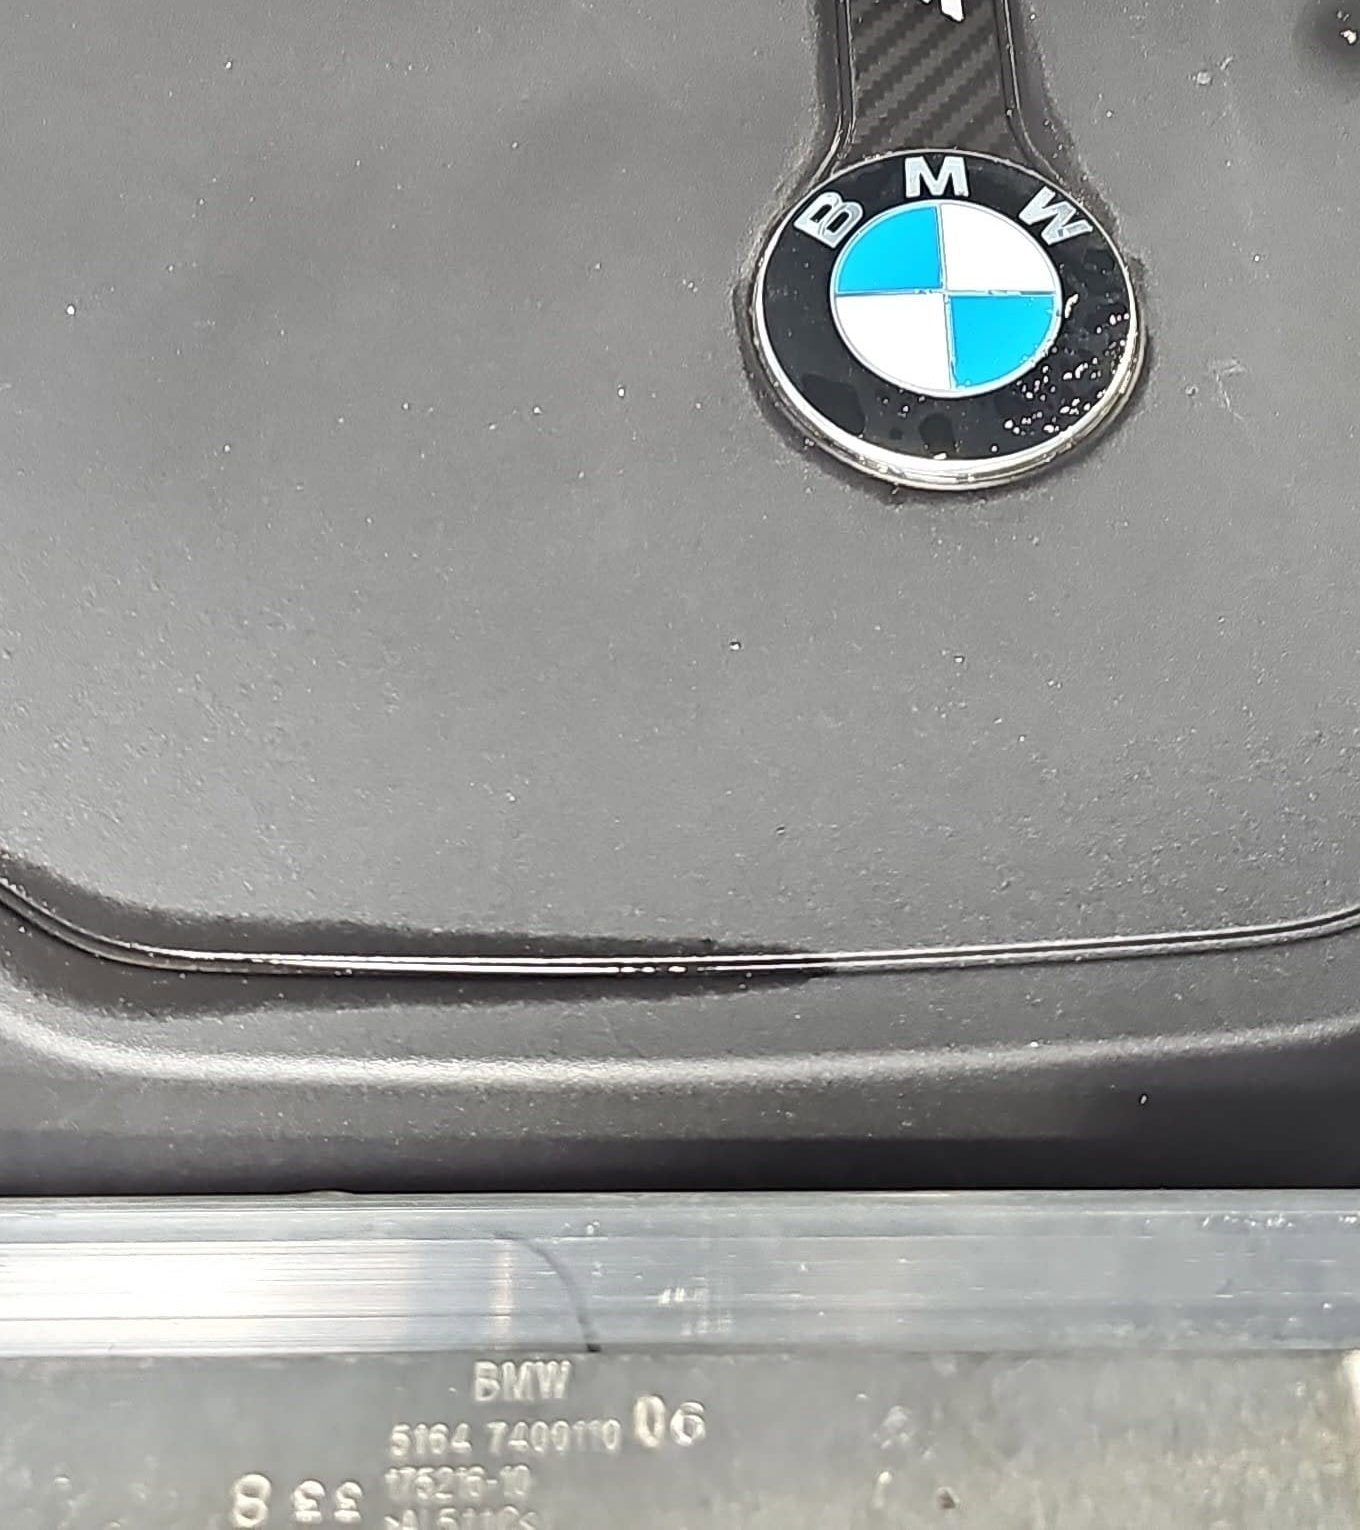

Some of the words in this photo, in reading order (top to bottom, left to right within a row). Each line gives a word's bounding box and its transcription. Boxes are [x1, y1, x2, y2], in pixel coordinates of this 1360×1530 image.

[793, 156, 1093, 249] BMW
[474, 1360, 572, 1402] BMW
[391, 1422, 472, 1456] 5164
